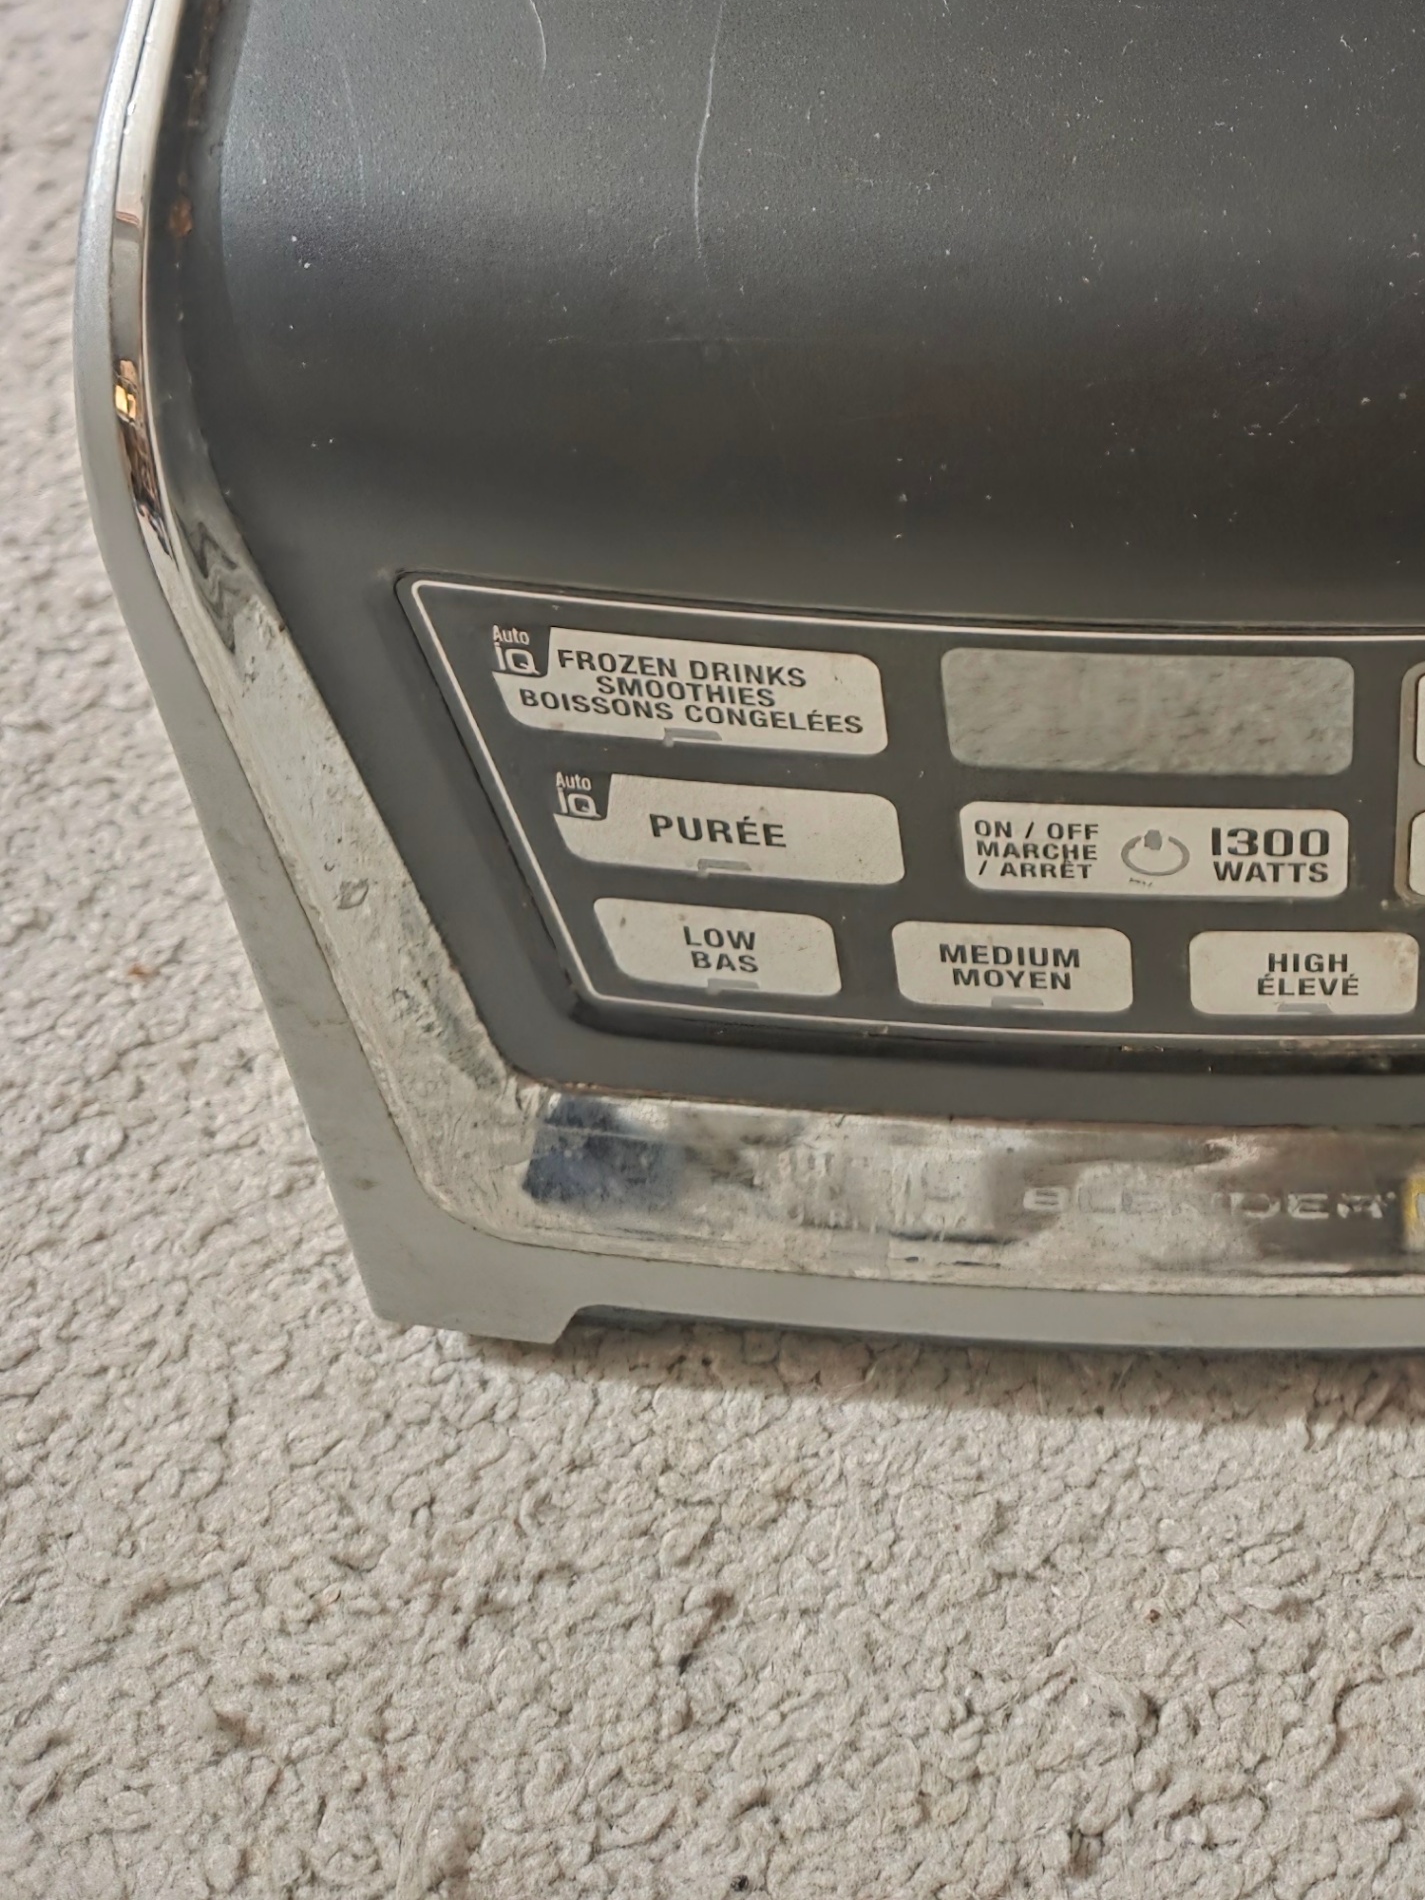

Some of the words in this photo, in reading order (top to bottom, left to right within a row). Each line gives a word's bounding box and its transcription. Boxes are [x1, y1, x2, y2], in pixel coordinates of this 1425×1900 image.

[492, 625, 530, 646] Auto
[557, 649, 677, 678] FROZEN
[690, 660, 806, 688] DRINKS
[597, 675, 775, 707] SMOOTHIES
[520, 688, 673, 721] BOISSONS
[685, 702, 863, 735] CONGELÉES
[556, 771, 592, 791] Auto
[650, 814, 787, 848] PURÉE
[974, 819, 1012, 839] ON
[1047, 822, 1099, 841] OFF
[976, 840, 1098, 861] MARCHE
[1211, 827, 1330, 857] 1300
[1001, 856, 1092, 880] ARRÊT
[1213, 861, 1329, 883] WATTS
[684, 926, 756, 950] LOW
[692, 950, 758, 973] BAS
[939, 943, 1080, 968] MEDIUM
[1268, 953, 1348, 974] HIGH
[952, 968, 1071, 990] MOYEN
[1257, 973, 1359, 996] ÉLEVÉ
